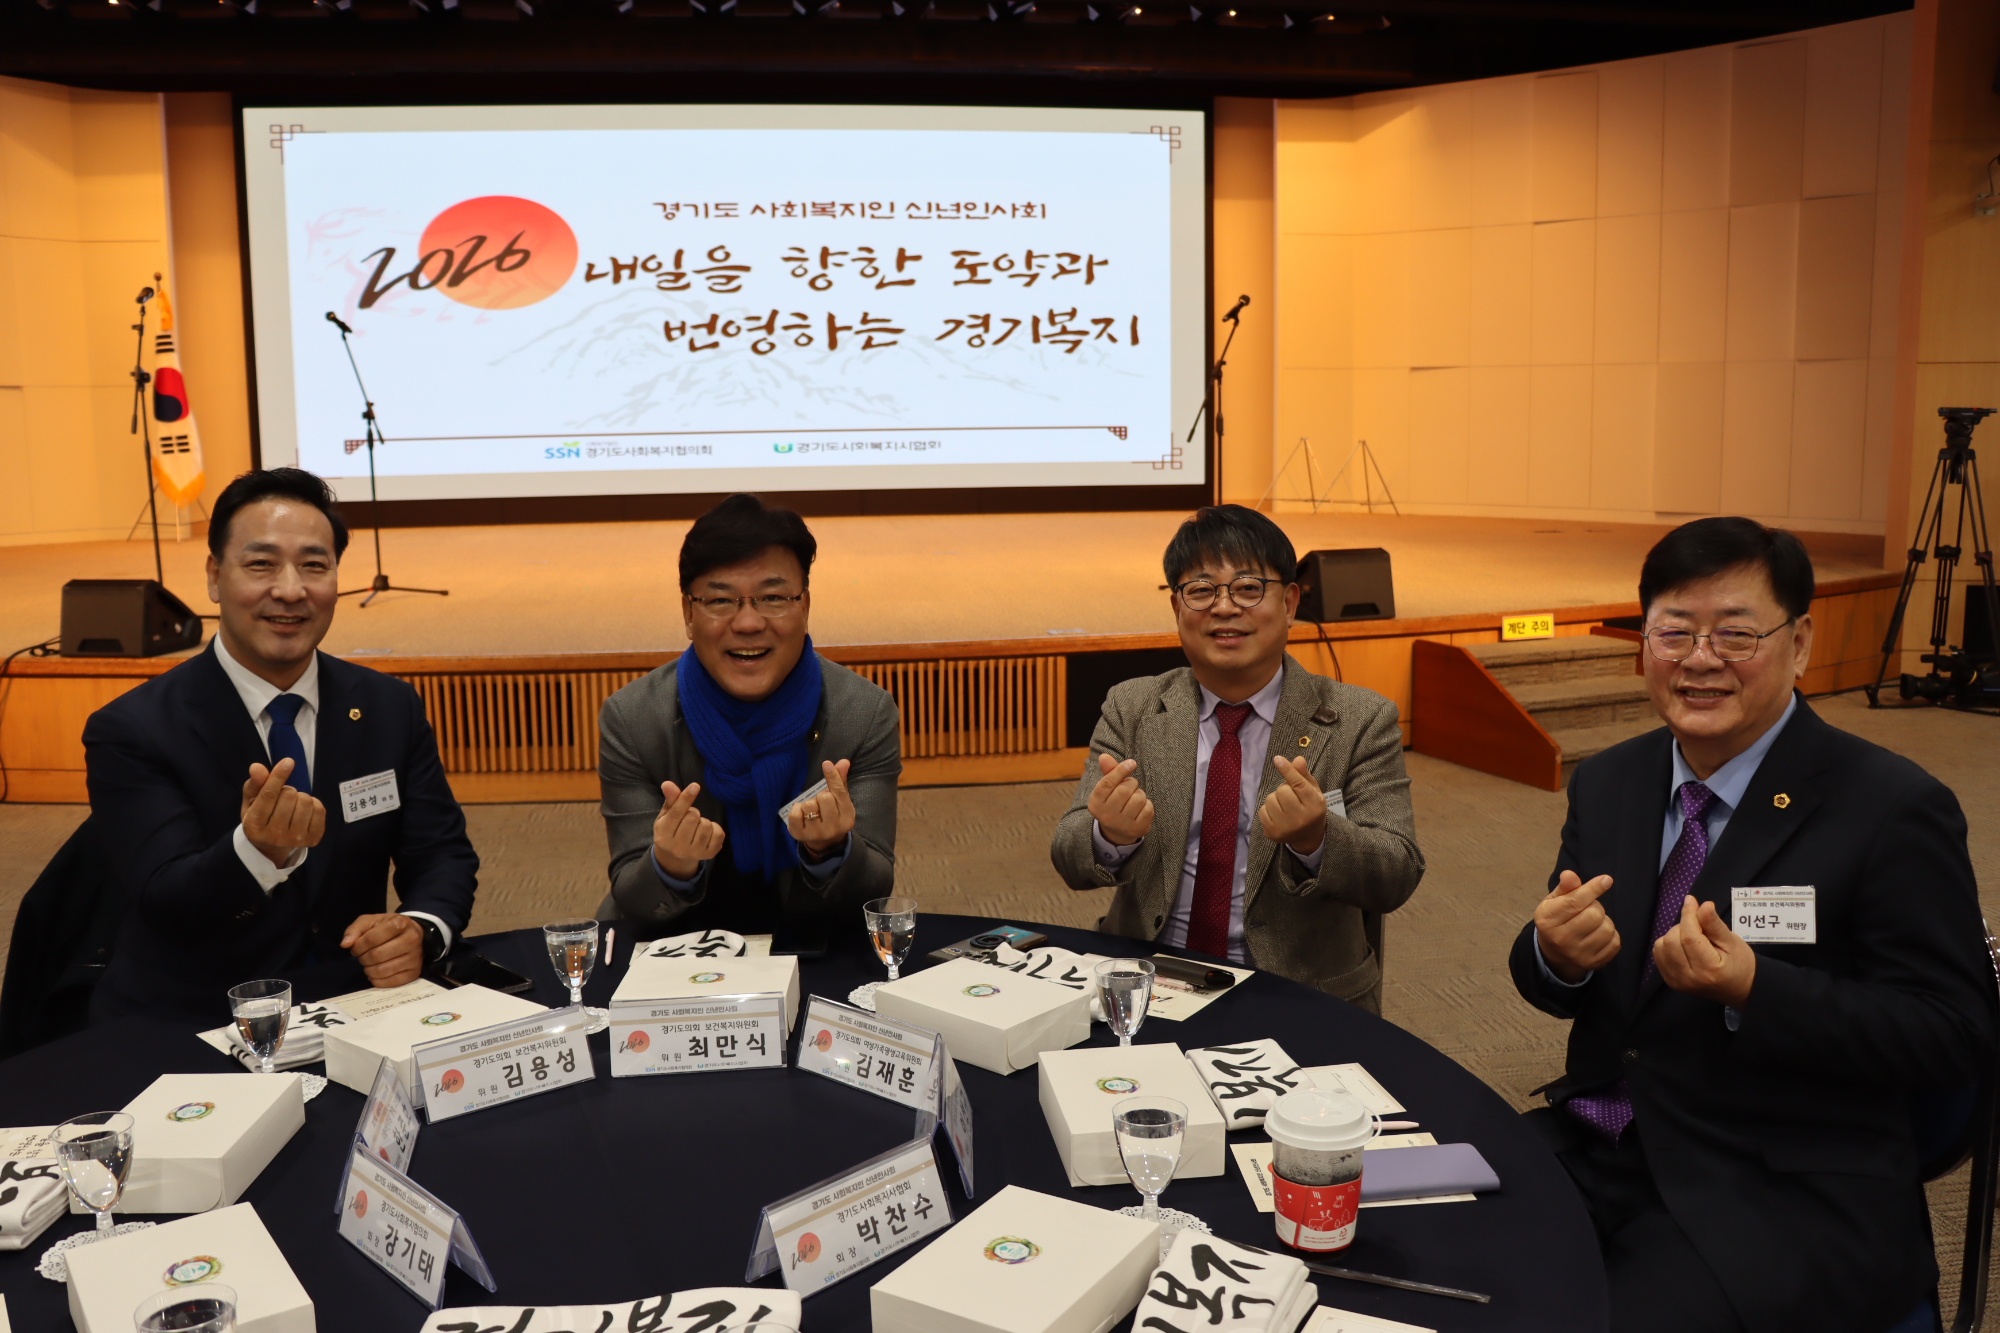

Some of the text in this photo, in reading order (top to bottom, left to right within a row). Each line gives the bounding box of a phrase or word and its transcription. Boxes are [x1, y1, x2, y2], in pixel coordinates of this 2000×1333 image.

[653, 200, 1046, 220] 경기도 사회복지인 신년인사회
[358, 230, 531, 309] 2026
[584, 245, 1108, 293] 내일을 향한 도약과
[664, 307, 1140, 355] 번영하는 경기복지
[545, 448, 580, 458] SSN
[586, 445, 713, 458] 경기도사회복지협의회
[1508, 620, 1549, 634] 계단 주의
[1739, 915, 1780, 928] 이선구
[1786, 922, 1806, 930] 위원장
[650, 1005, 737, 1017] 경기도 사회복지인 신년인사회
[838, 1014, 852, 1024] 경기도
[661, 1019, 758, 1034] 경기도의회 보건복지위원회
[835, 1030, 861, 1045] 경기도의회
[458, 1041, 479, 1053] 경기도
[473, 1036, 567, 1068] 경기도의회 보건복지위원회
[618, 1037, 644, 1053] 2026
[688, 1033, 766, 1058] 최만식
[503, 1048, 576, 1089] 김용성
[856, 1052, 915, 1093] 김재훈
[811, 1166, 896, 1210] 경기도 사회복지인 신년인사회
[836, 1180, 912, 1224] 경기도사회복지사협회
[381, 1201, 428, 1241] 경기도사회복지협의회
[835, 1193, 934, 1264] 회장 박찬수
[367, 1224, 434, 1283] 회장 강기태
